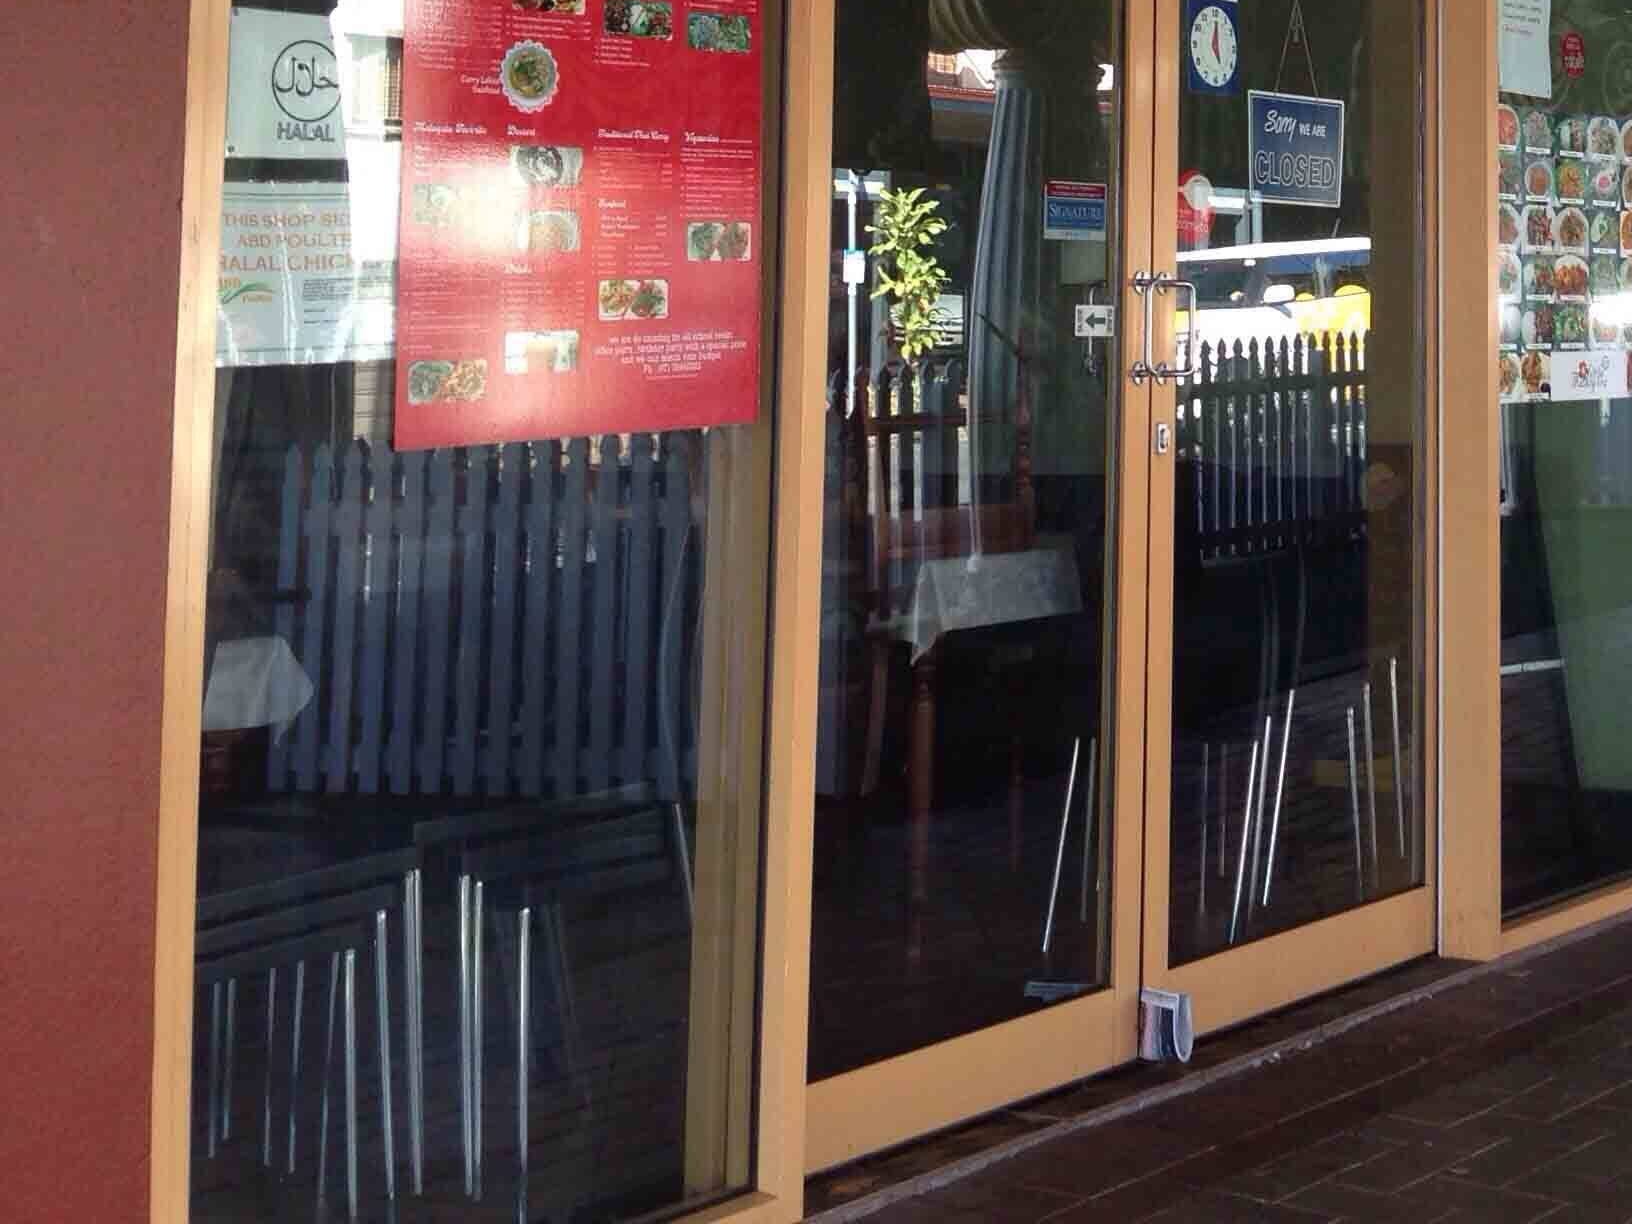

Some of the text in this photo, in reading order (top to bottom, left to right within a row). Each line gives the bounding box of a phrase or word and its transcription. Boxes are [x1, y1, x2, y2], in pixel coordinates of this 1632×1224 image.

[276, 122, 336, 143] HALAL
[1264, 109, 1328, 144] Sorry WE ARE
[1254, 149, 1337, 189] CLOSED
[223, 213, 259, 227] THIS
[262, 214, 315, 227] SHOP
